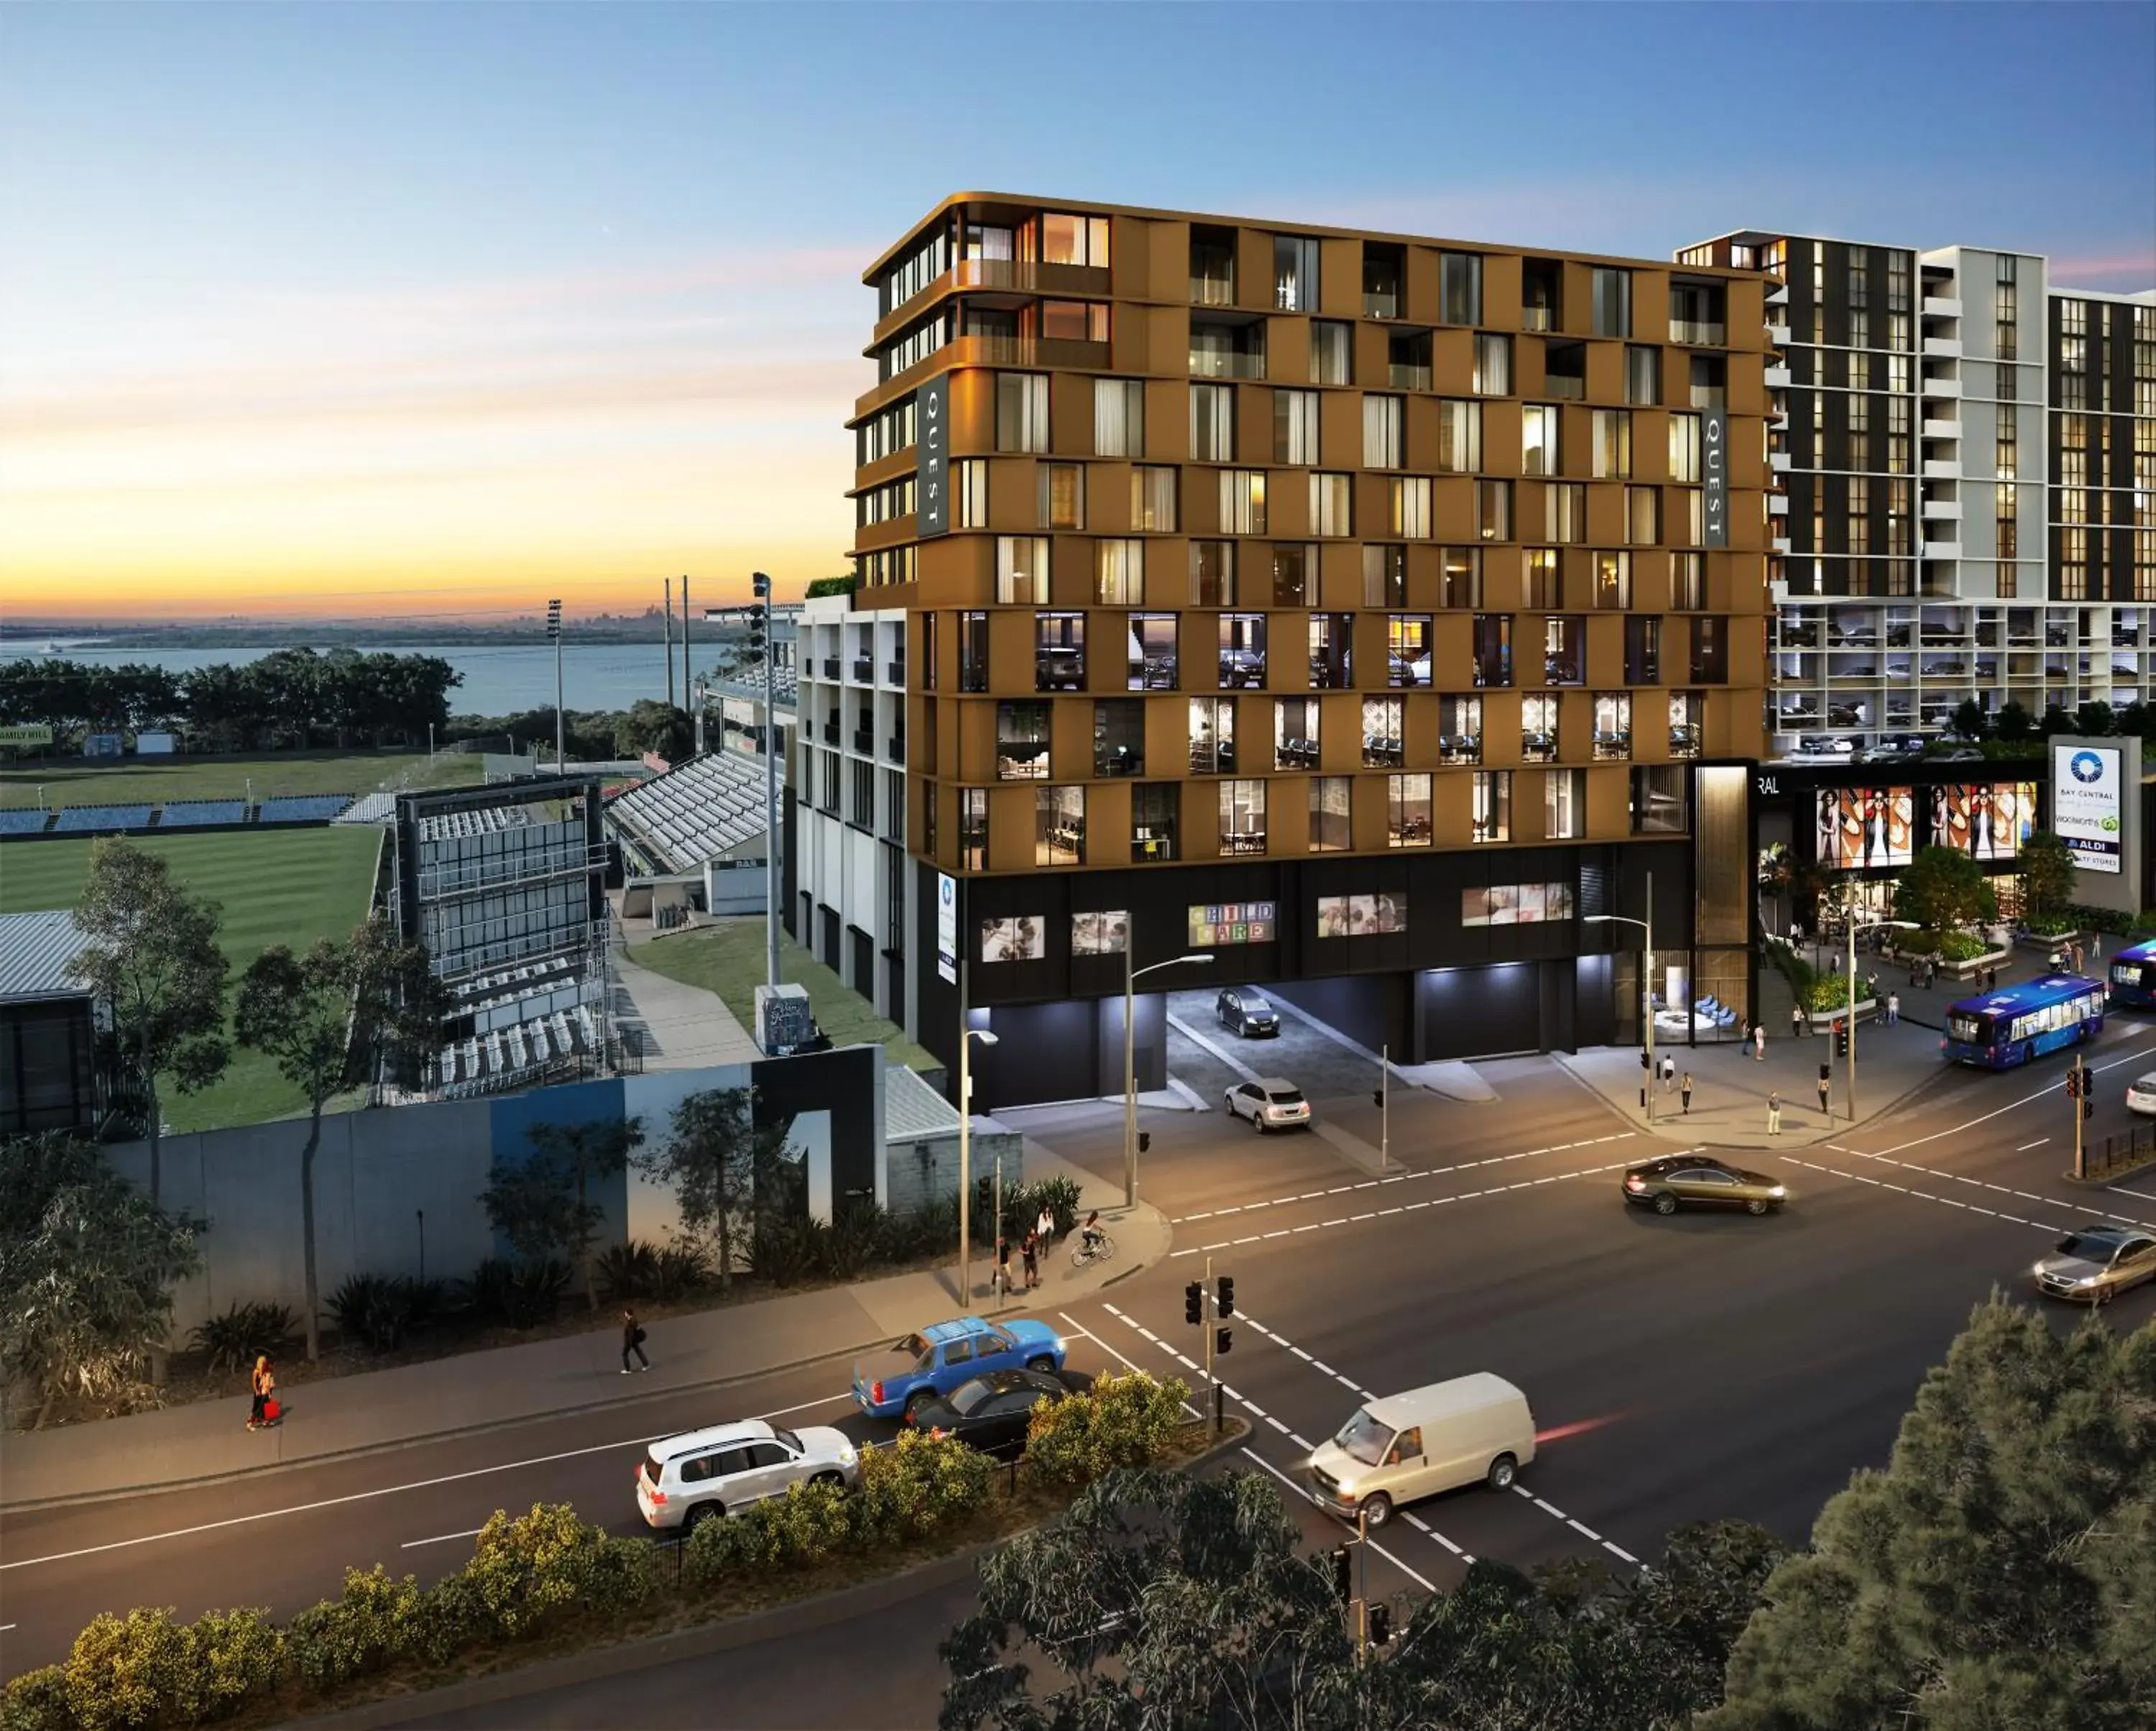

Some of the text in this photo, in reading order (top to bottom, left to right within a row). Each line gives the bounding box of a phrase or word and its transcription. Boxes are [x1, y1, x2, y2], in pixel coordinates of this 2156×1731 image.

[927, 392, 939, 524] QUEST
[1706, 418, 1720, 535] QUEST
[2078, 791, 2114, 800] CENTRAL
[2080, 840, 2106, 851] ALDI
[1190, 904, 1273, 924] CHILD
[1197, 923, 1264, 943] CARE
